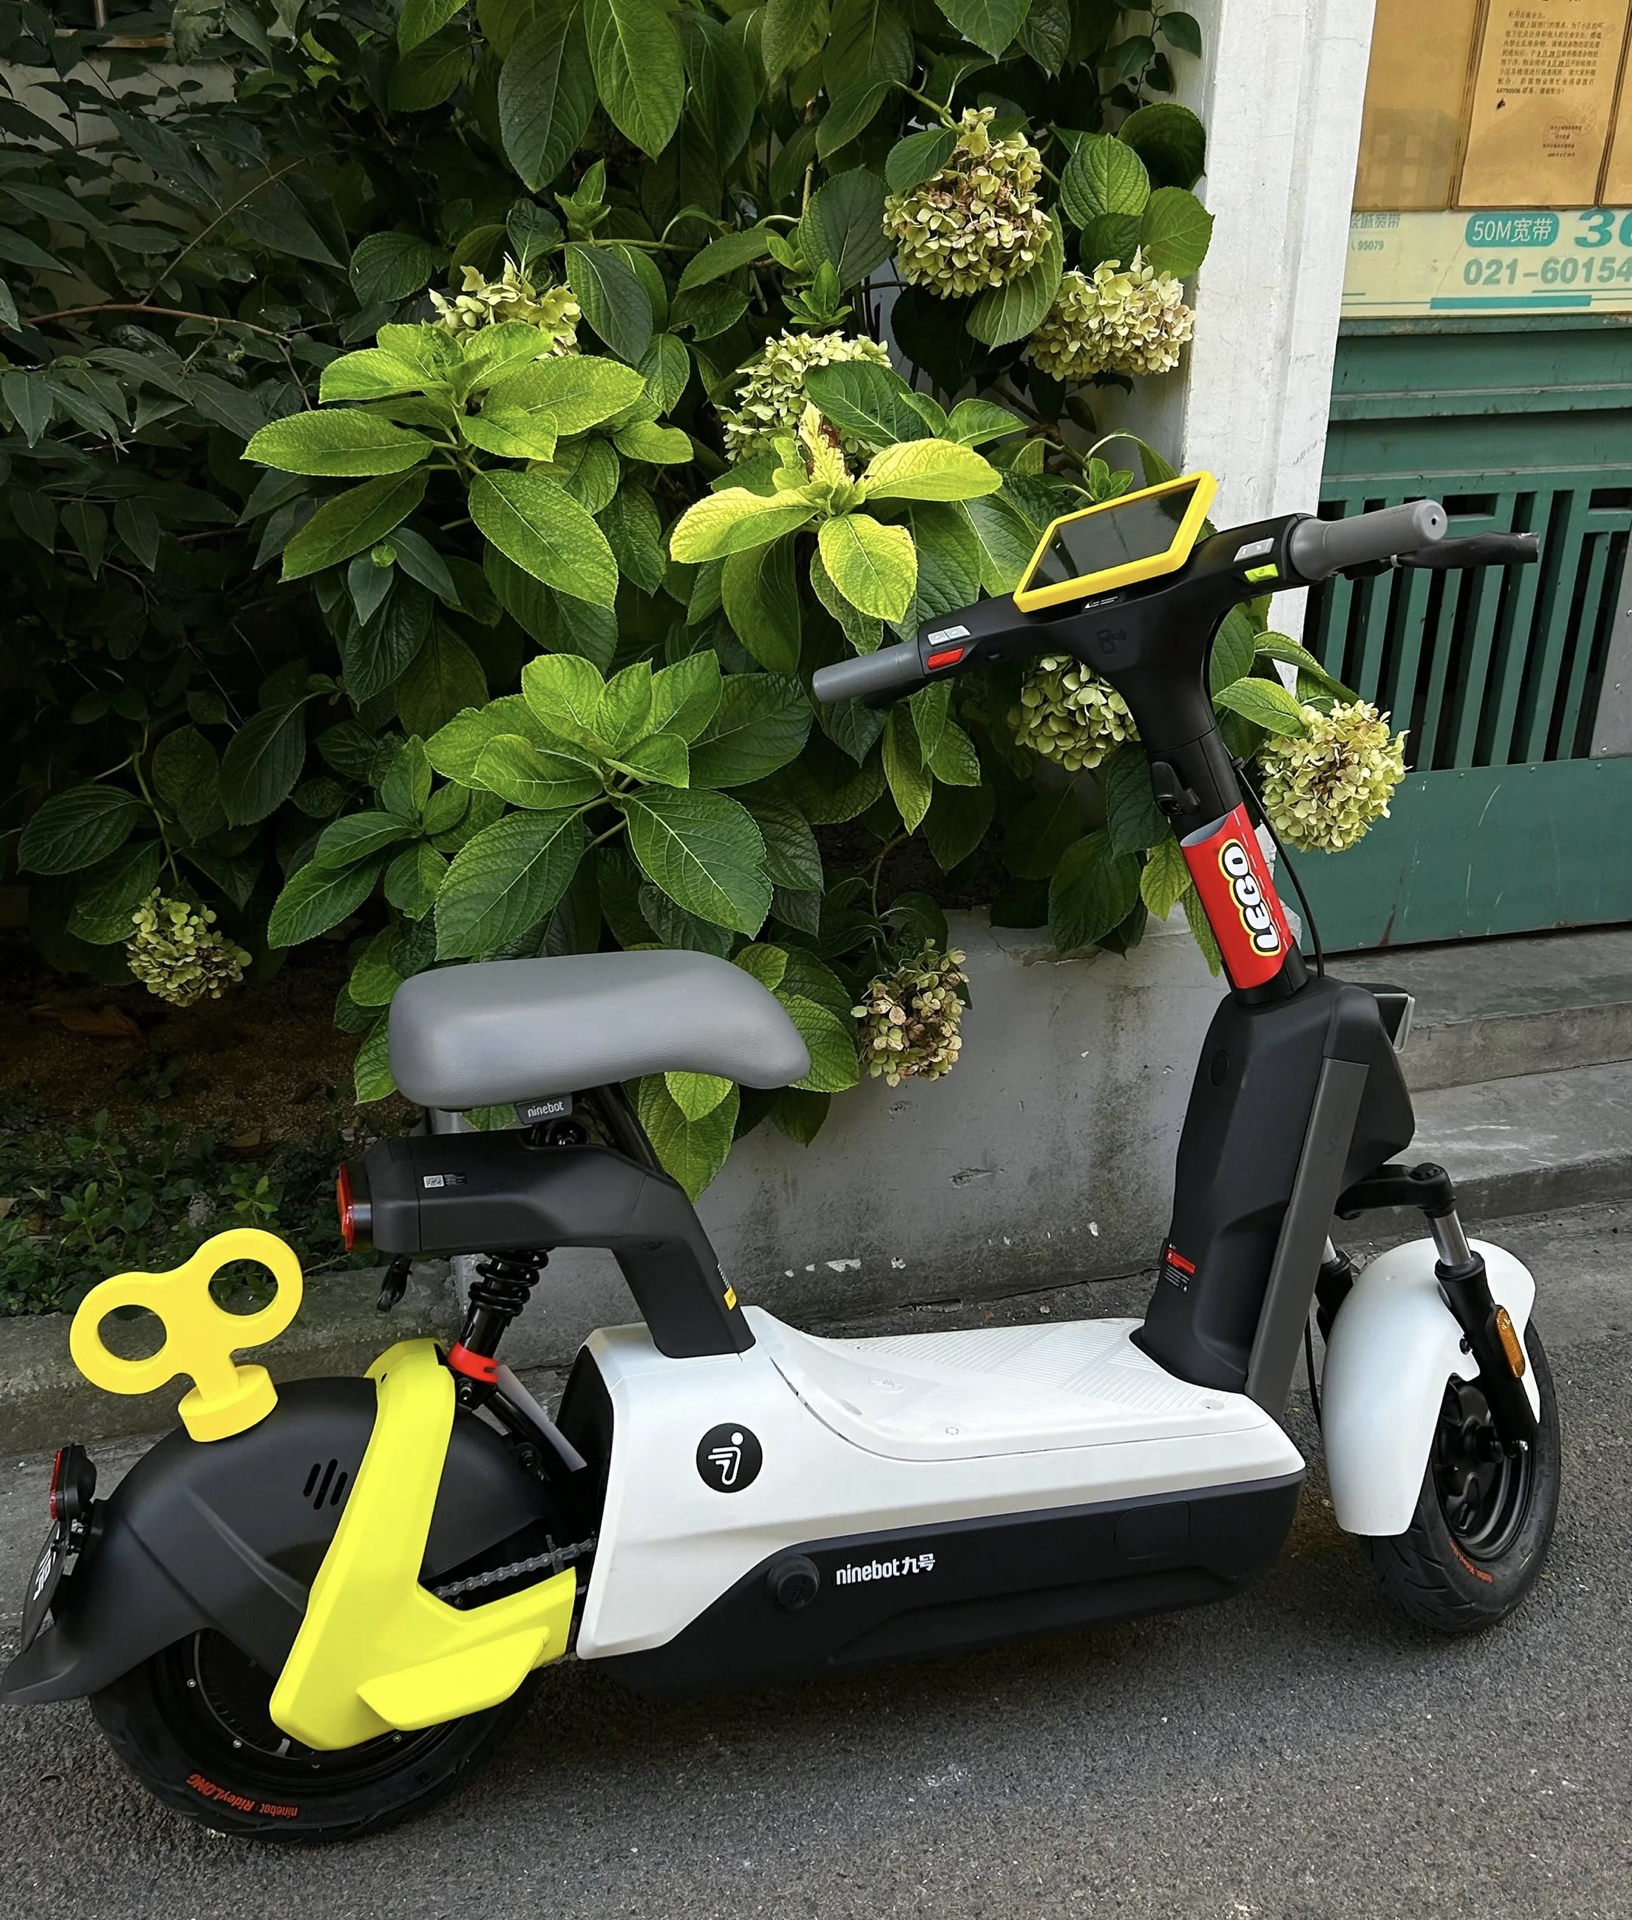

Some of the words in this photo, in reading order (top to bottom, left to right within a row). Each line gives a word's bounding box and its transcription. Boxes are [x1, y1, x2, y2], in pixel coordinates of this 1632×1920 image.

[1472, 217, 1553, 242] 50M宽带
[1357, 240, 1385, 251] 95079
[1463, 256, 1632, 286] 021-60154
[1220, 841, 1280, 954] LEGO
[527, 1100, 565, 1118] ninebot
[258, 1803, 298, 1818] ninebot
